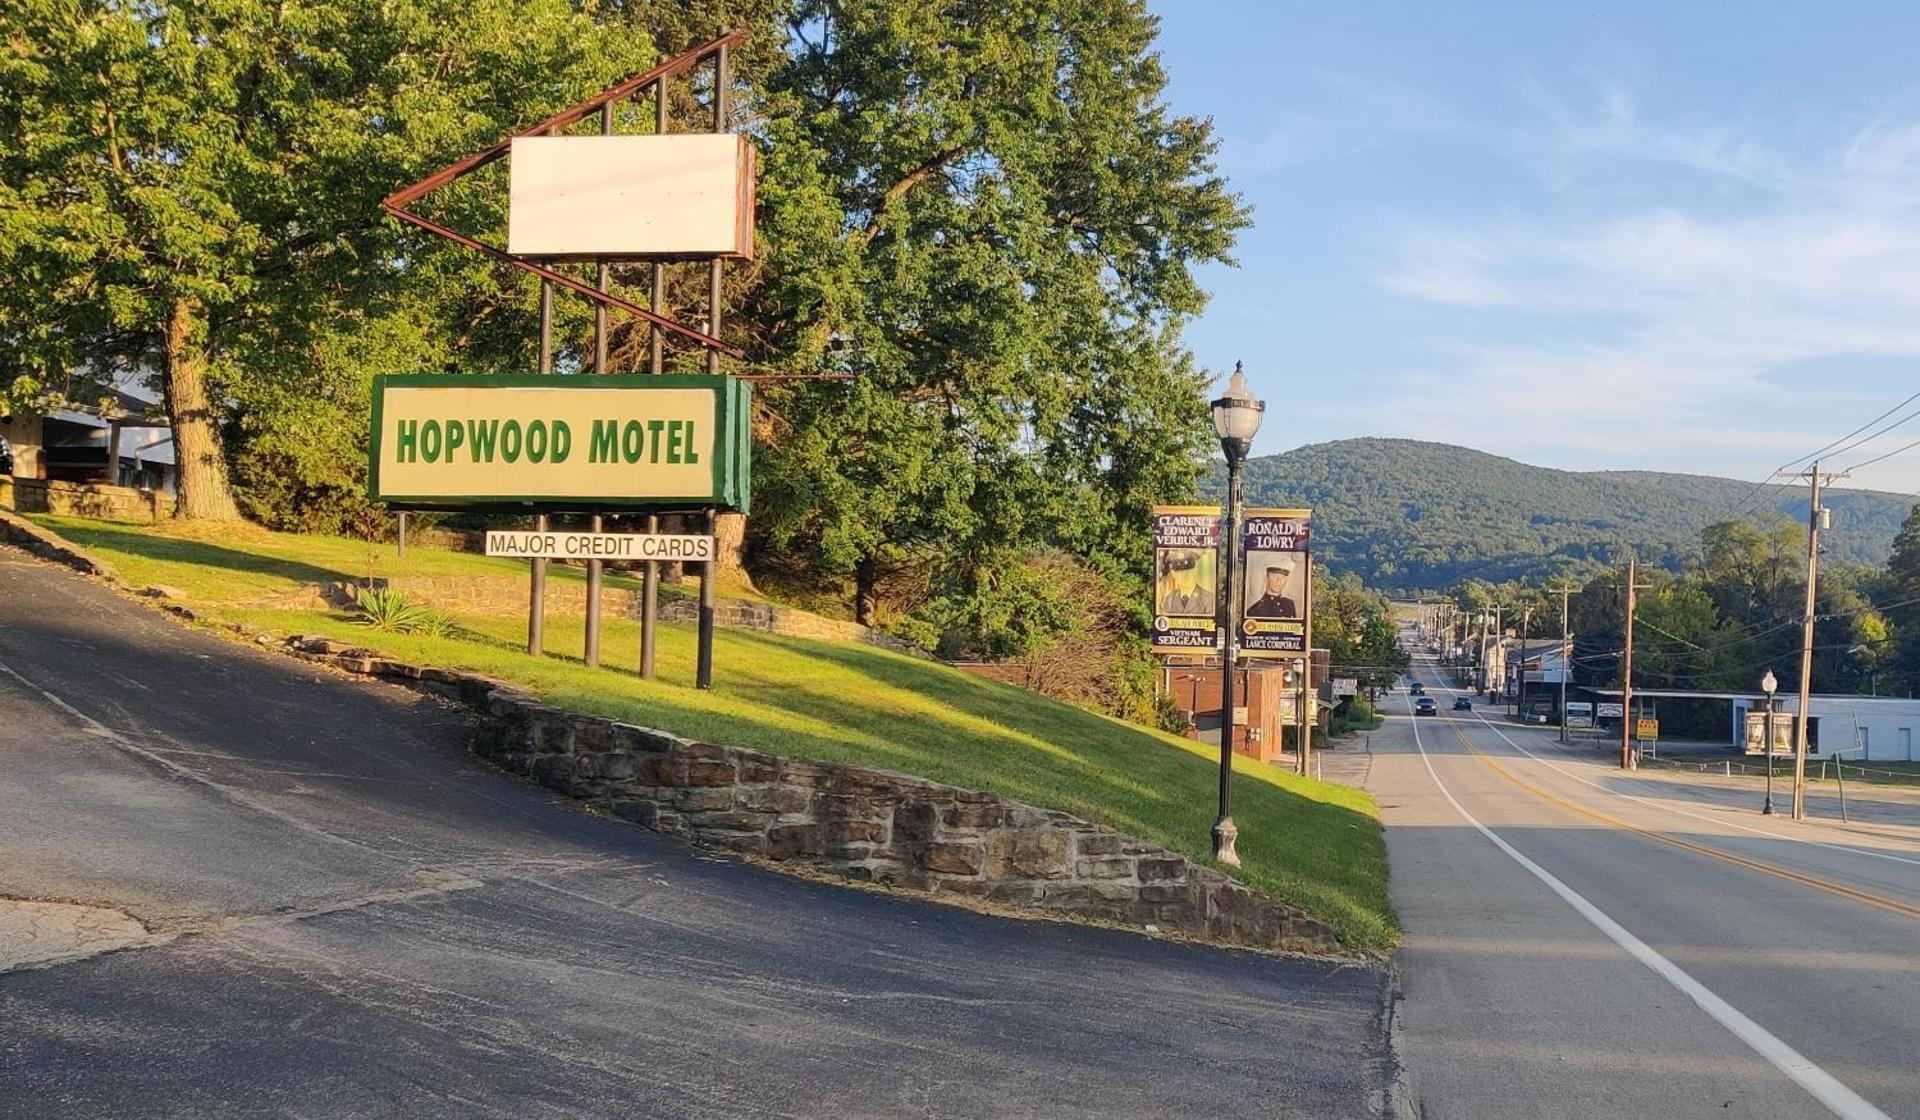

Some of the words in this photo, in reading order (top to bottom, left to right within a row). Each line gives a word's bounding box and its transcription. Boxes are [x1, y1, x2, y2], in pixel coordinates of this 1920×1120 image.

[396, 419, 572, 464] HOPWOOD
[588, 419, 699, 464] MOTEL
[1159, 516, 1216, 527] CLARENCE
[1163, 526, 1211, 536] EDWARD
[1248, 522, 1293, 535] RONALD
[490, 534, 556, 555] MAJOR
[565, 535, 632, 556] CREDIT
[642, 537, 709, 558] CARDS
[1156, 535, 1201, 546] VERBUS,
[1201, 536, 1217, 546] JR.
[1257, 535, 1296, 549] LOWRY
[1158, 636, 1213, 645] SERGEANT
[1246, 640, 1267, 648] LANCE
[1267, 640, 1302, 650] CORPORAL
